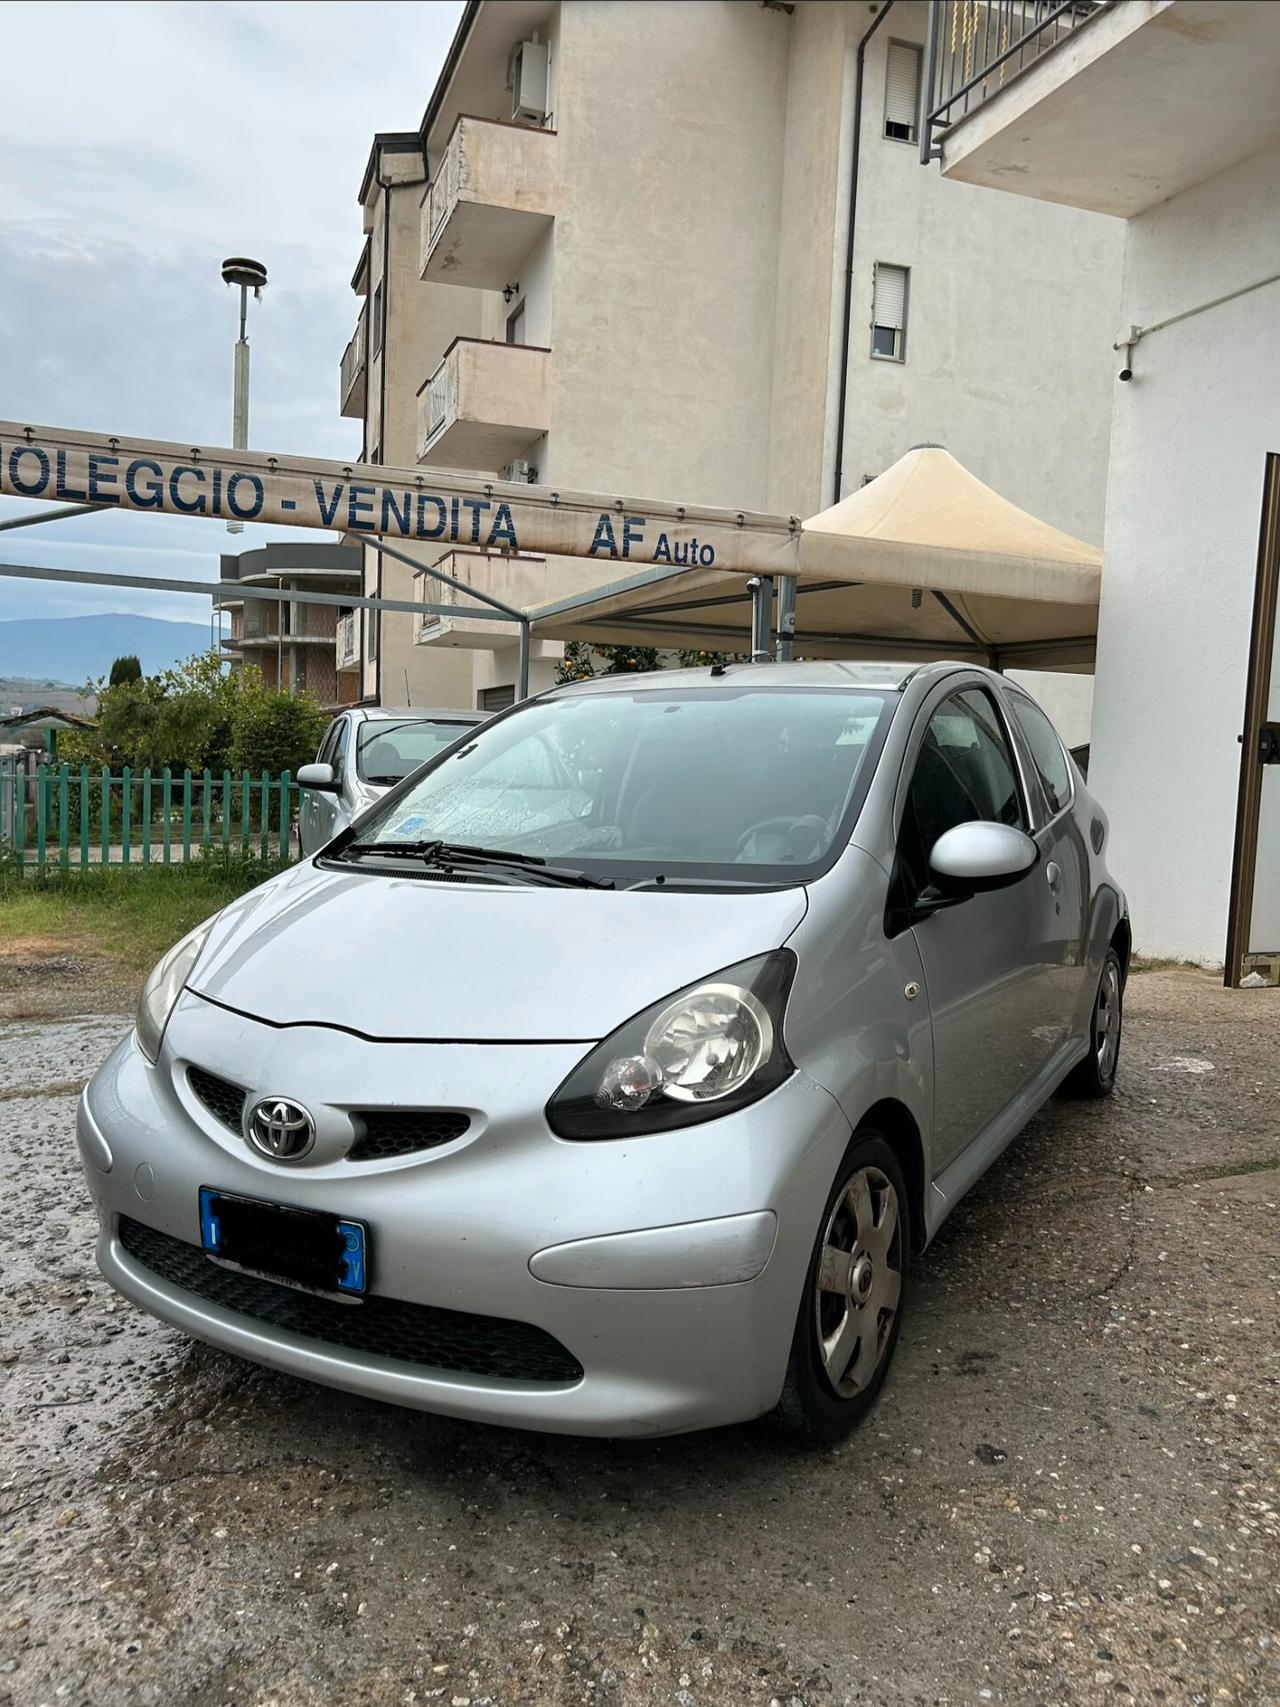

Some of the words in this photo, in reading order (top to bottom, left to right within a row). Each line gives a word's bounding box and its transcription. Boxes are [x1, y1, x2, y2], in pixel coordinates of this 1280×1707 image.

[0, 446, 265, 519] OLEGGIO
[313, 480, 518, 547] VENDITA
[588, 513, 646, 559] AF
[652, 533, 715, 566] Auto
